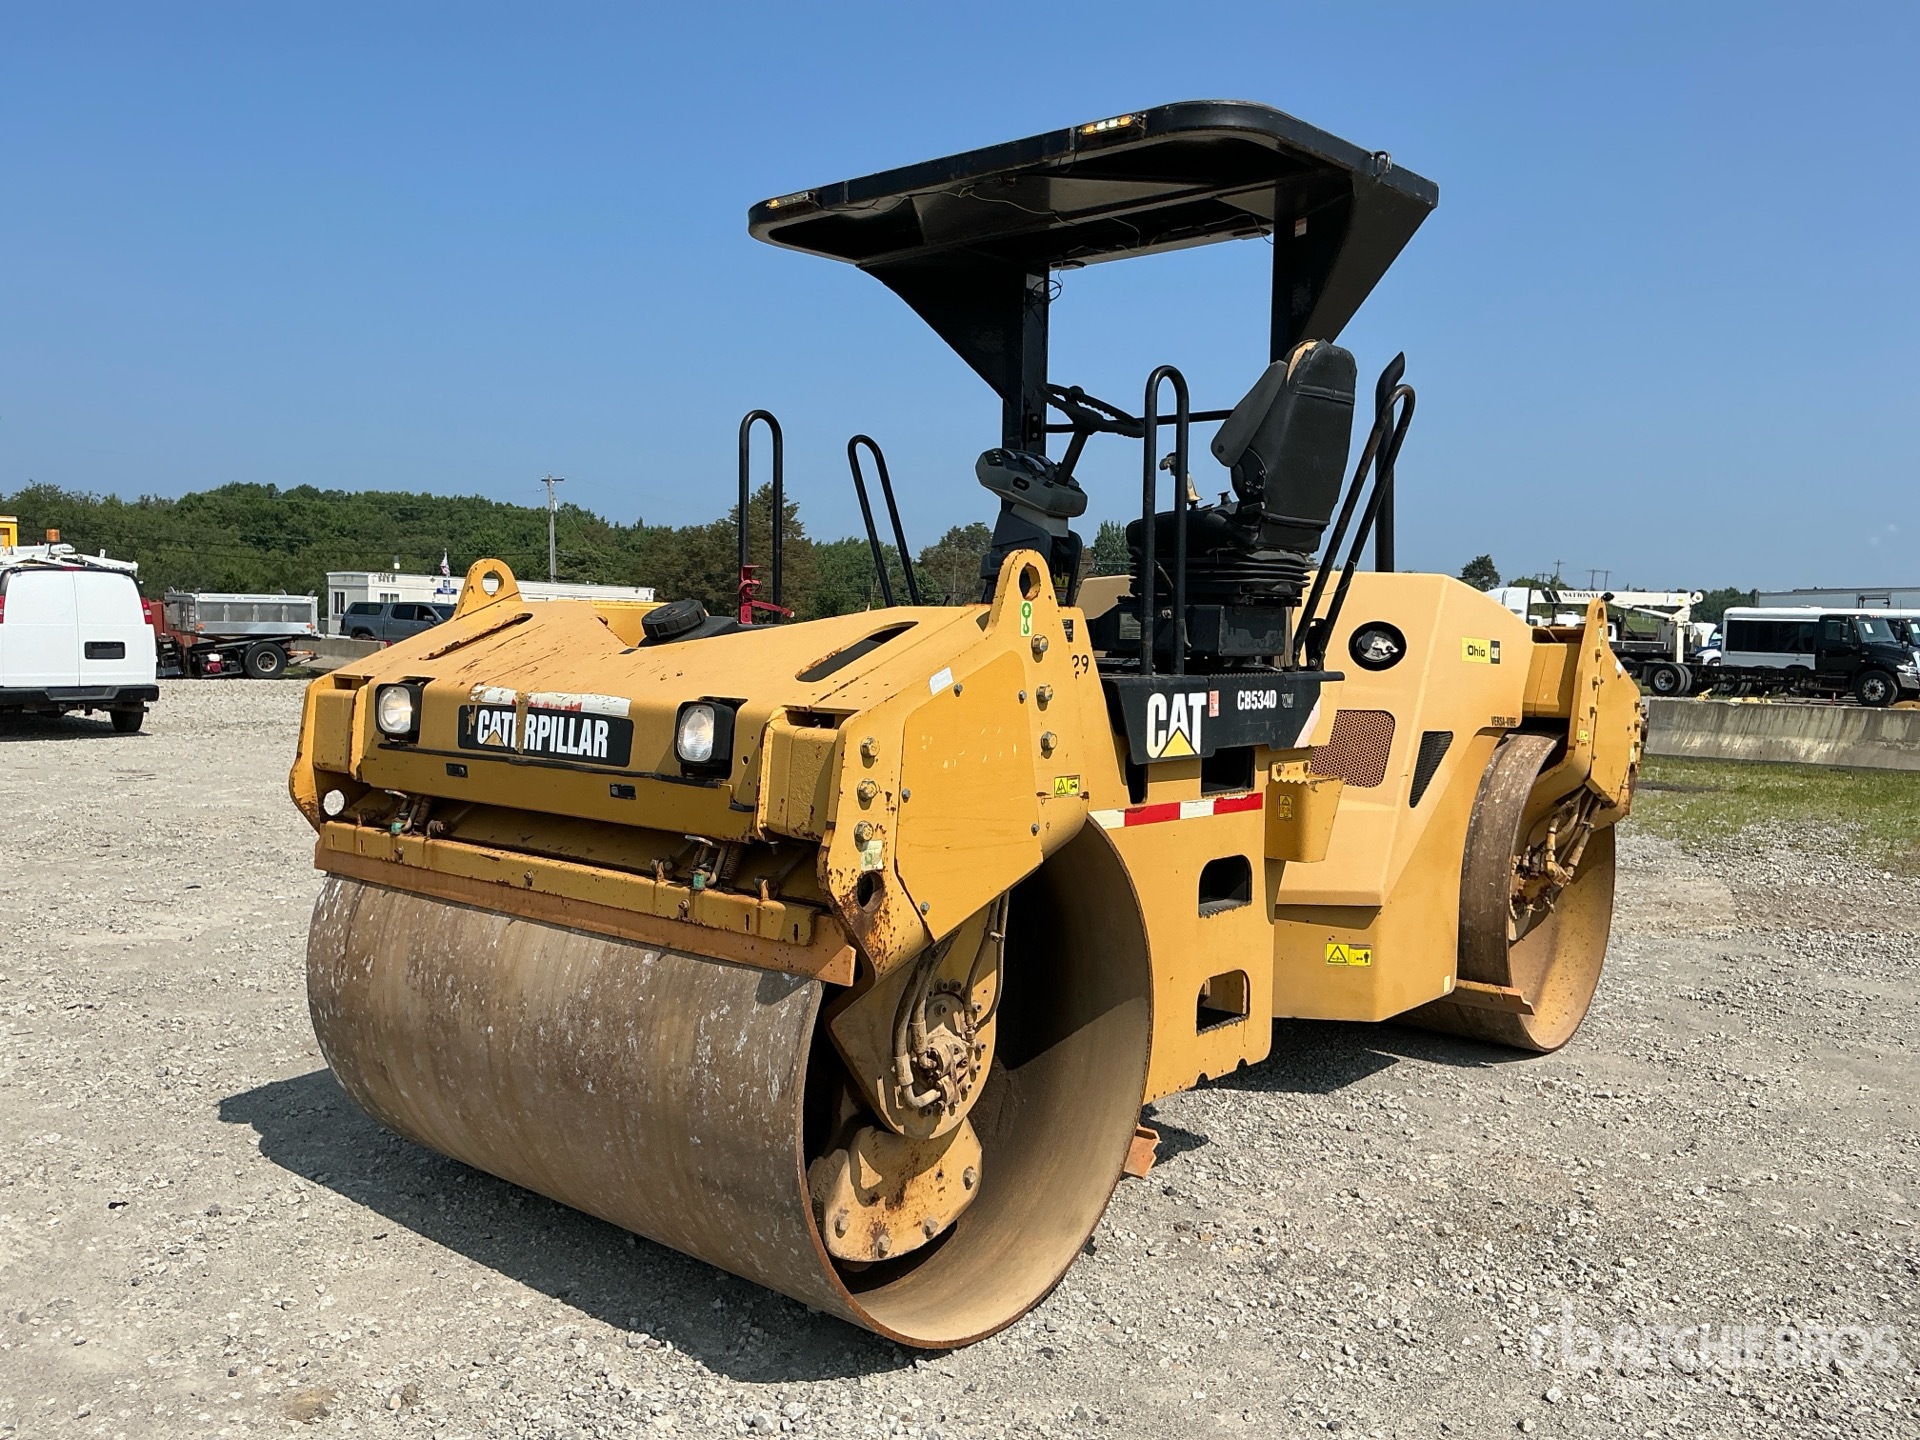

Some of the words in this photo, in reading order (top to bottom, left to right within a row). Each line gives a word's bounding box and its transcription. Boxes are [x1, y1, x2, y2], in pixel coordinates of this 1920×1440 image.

[1467, 645, 1486, 657] Ohio
[1237, 690, 1277, 711] CB534D
[1146, 692, 1207, 759] CAT
